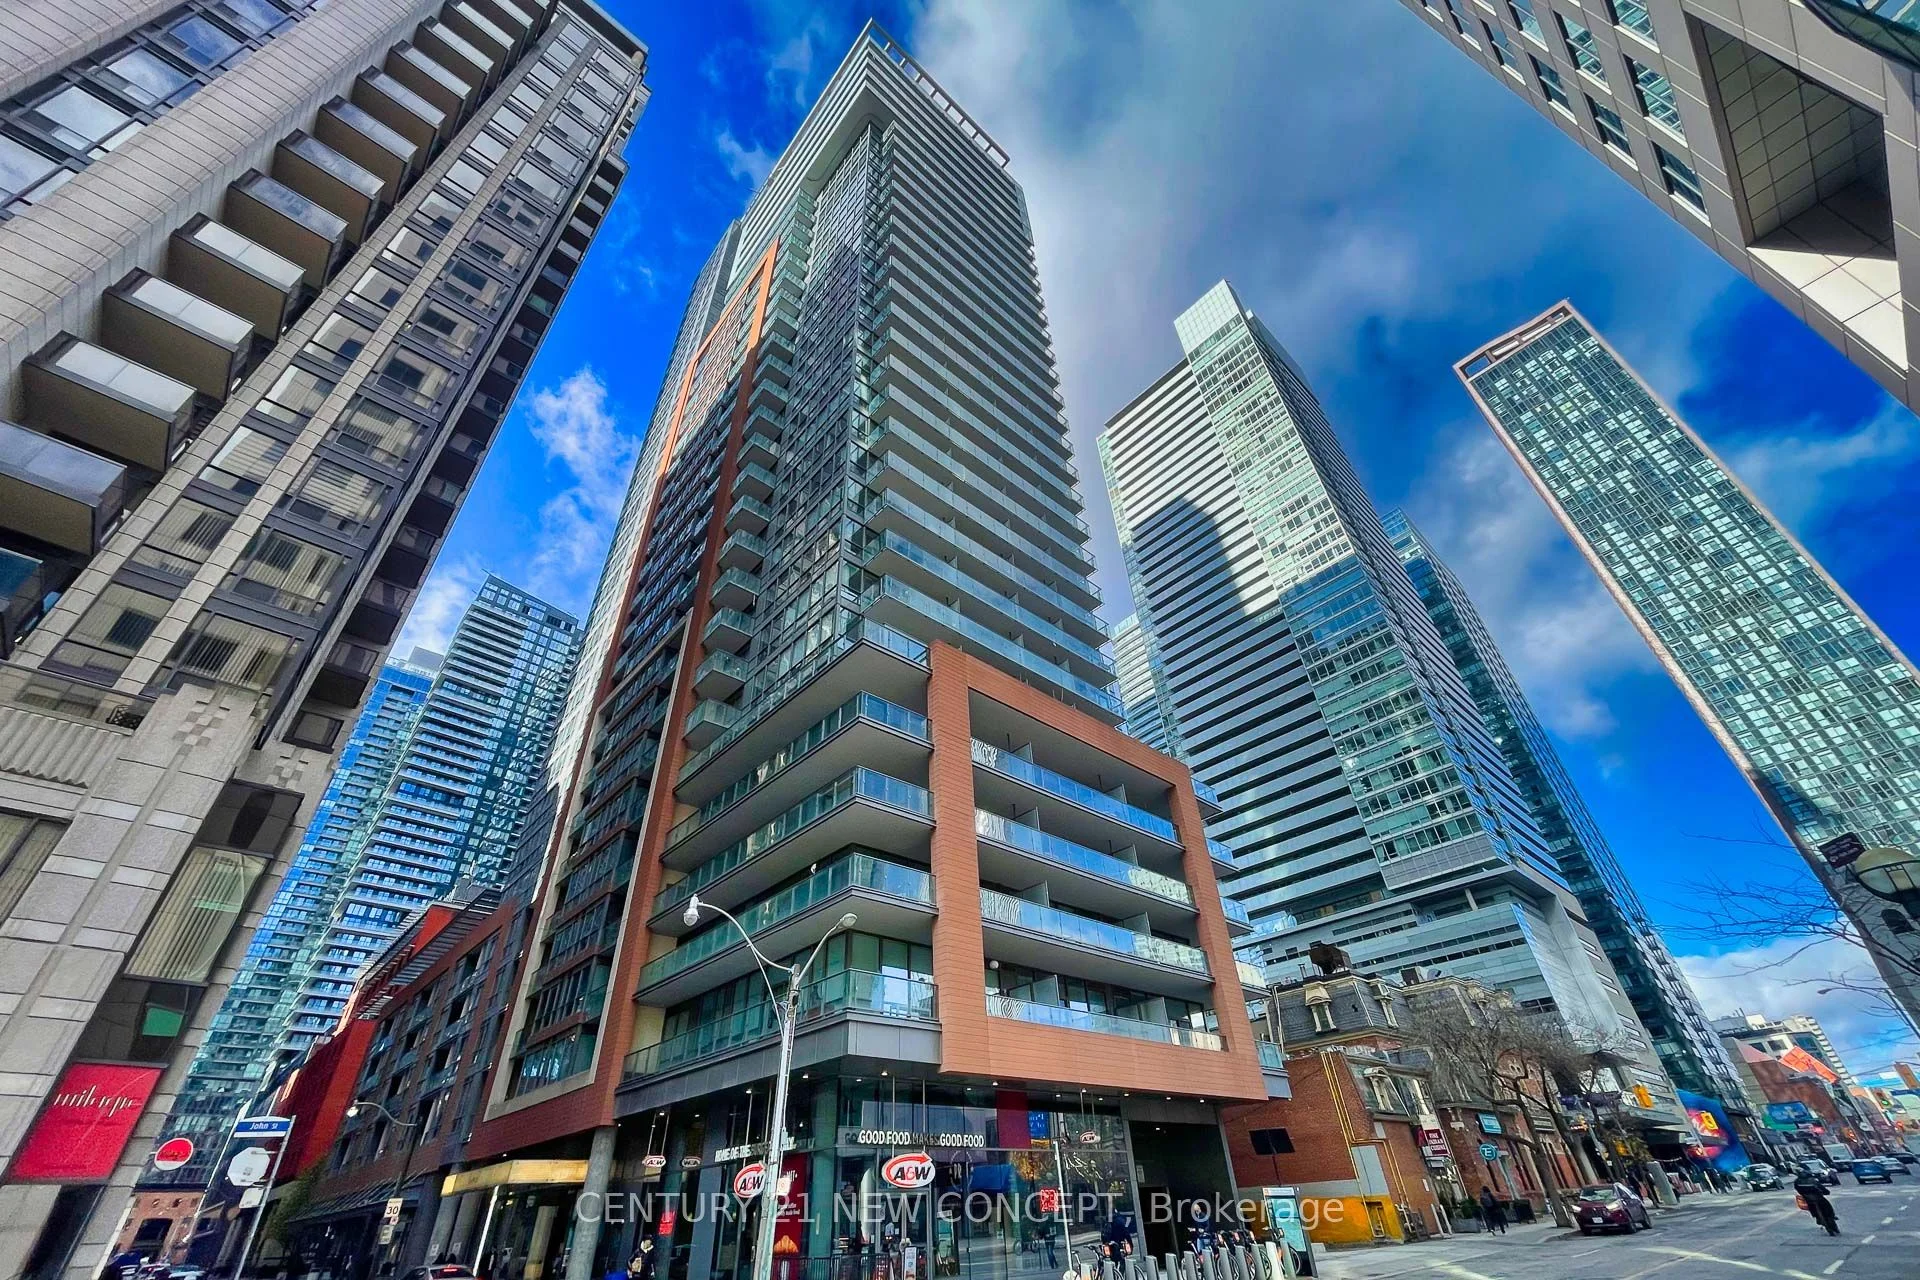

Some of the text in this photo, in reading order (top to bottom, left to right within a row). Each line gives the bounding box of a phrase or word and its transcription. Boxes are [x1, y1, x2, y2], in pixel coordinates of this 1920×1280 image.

[250, 1122, 268, 1130] John
[859, 1130, 885, 1144] GOOD
[886, 1131, 911, 1145] FOOD
[912, 1132, 940, 1146] MAKES
[940, 1133, 962, 1147] GOOD
[963, 1134, 985, 1148] FOOD
[894, 1166, 932, 1181] A&W
[739, 1174, 765, 1191] A&W
[386, 1206, 399, 1215] 30
